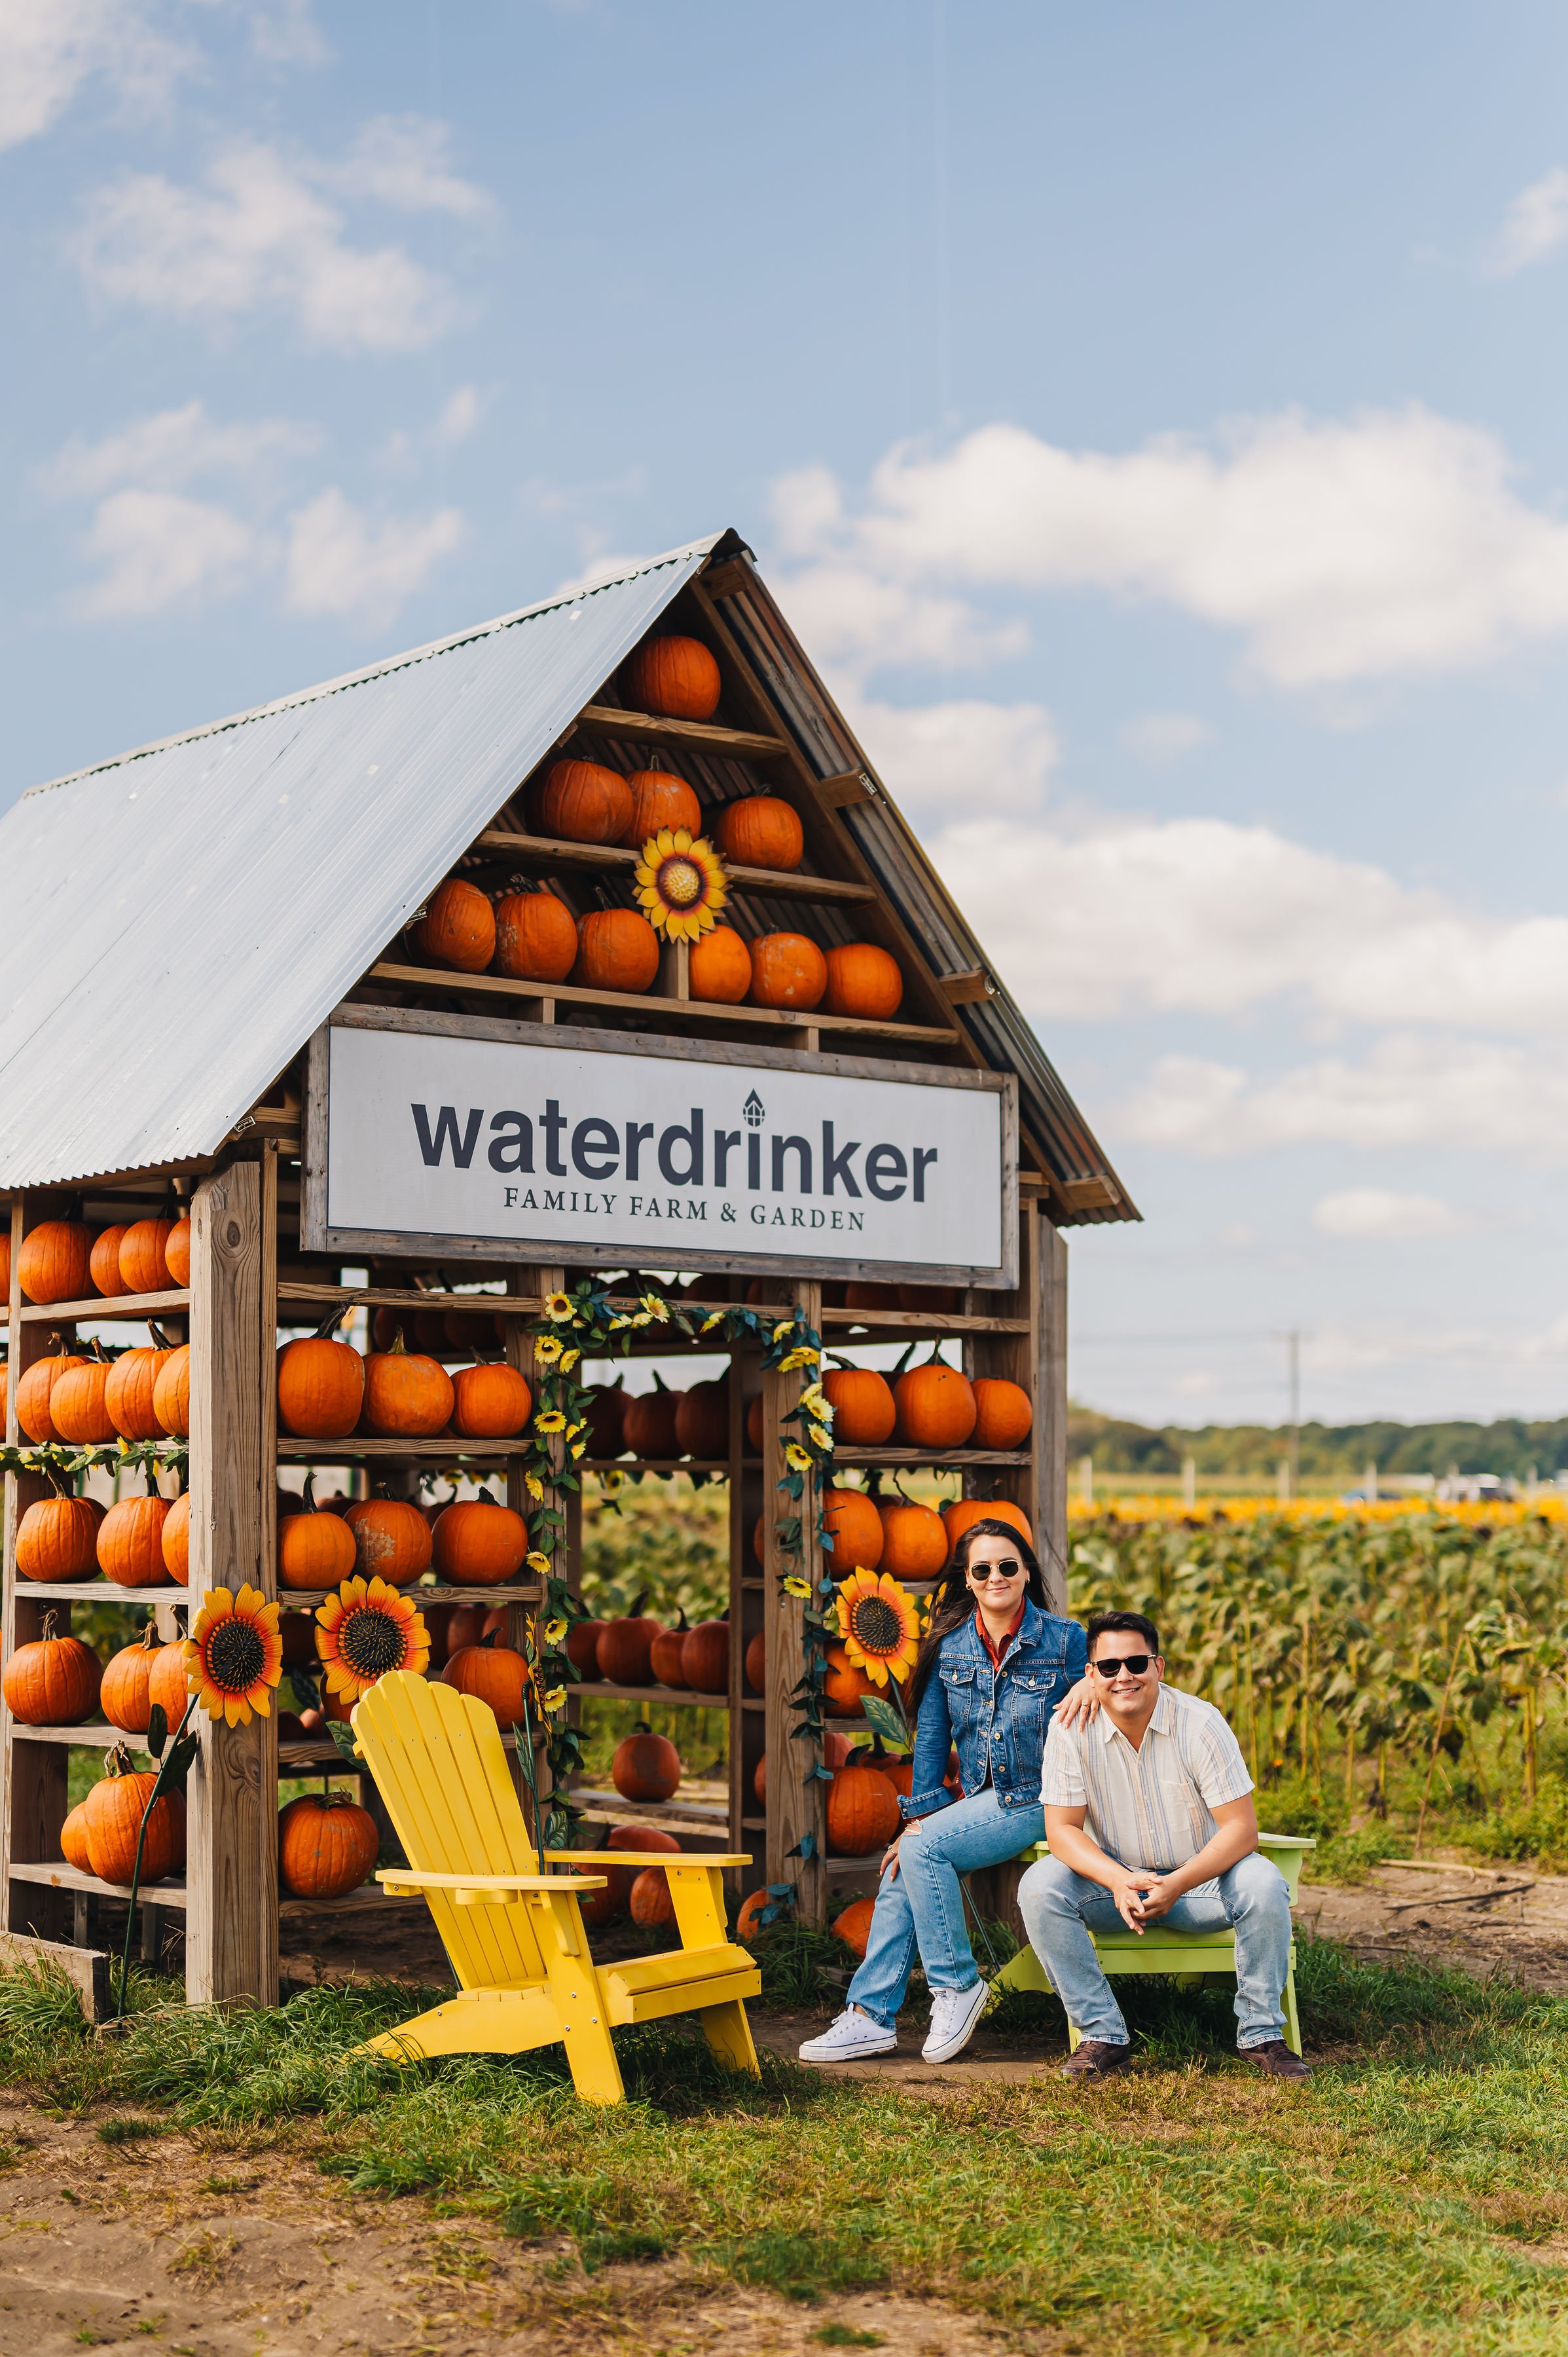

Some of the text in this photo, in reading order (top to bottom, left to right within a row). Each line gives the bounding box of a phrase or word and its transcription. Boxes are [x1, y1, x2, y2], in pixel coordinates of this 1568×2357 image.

[410, 1089, 938, 1203] waterdrinker
[503, 1187, 864, 1231] FAMILY FARM & GARDEN
